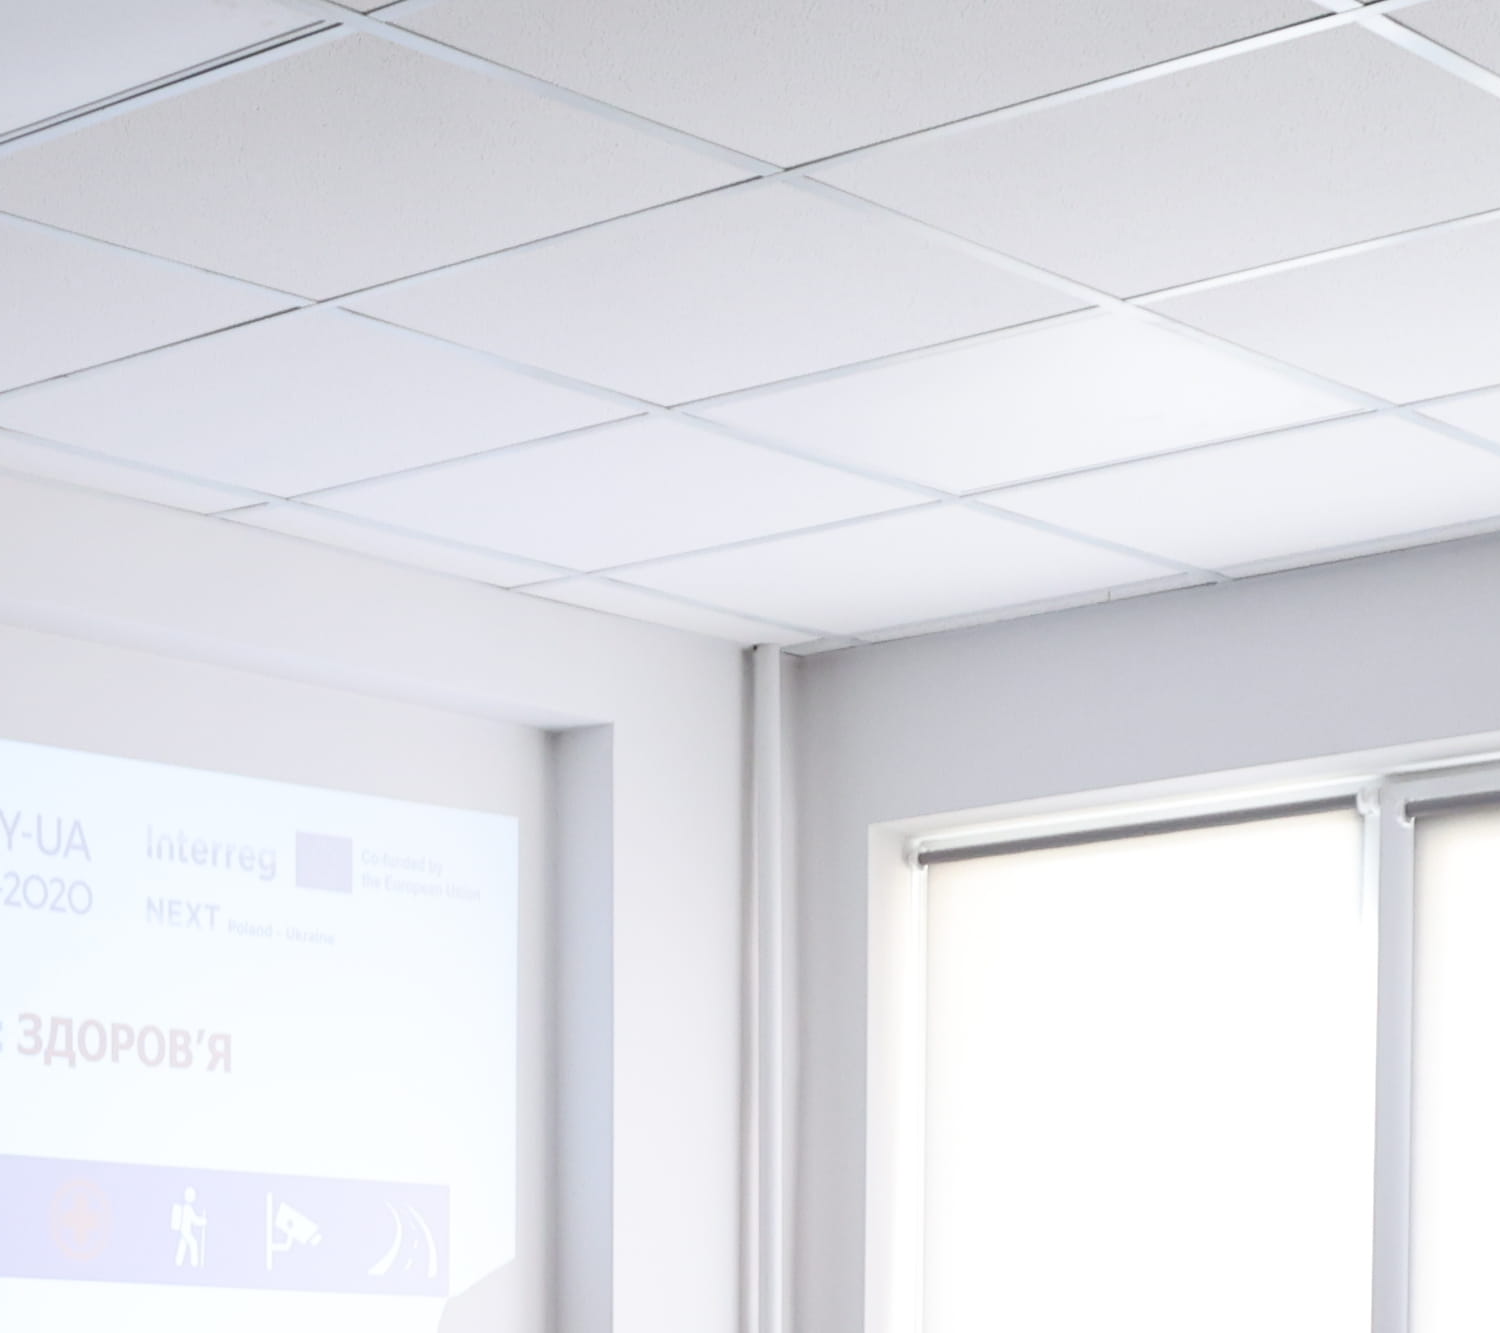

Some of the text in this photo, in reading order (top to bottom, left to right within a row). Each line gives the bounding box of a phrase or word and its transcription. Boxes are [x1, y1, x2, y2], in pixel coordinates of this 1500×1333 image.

[146, 826, 277, 881] Interreg
[145, 896, 219, 932] NEXT
[227, 918, 272, 937] Poland
[286, 927, 334, 946] Ukraine
